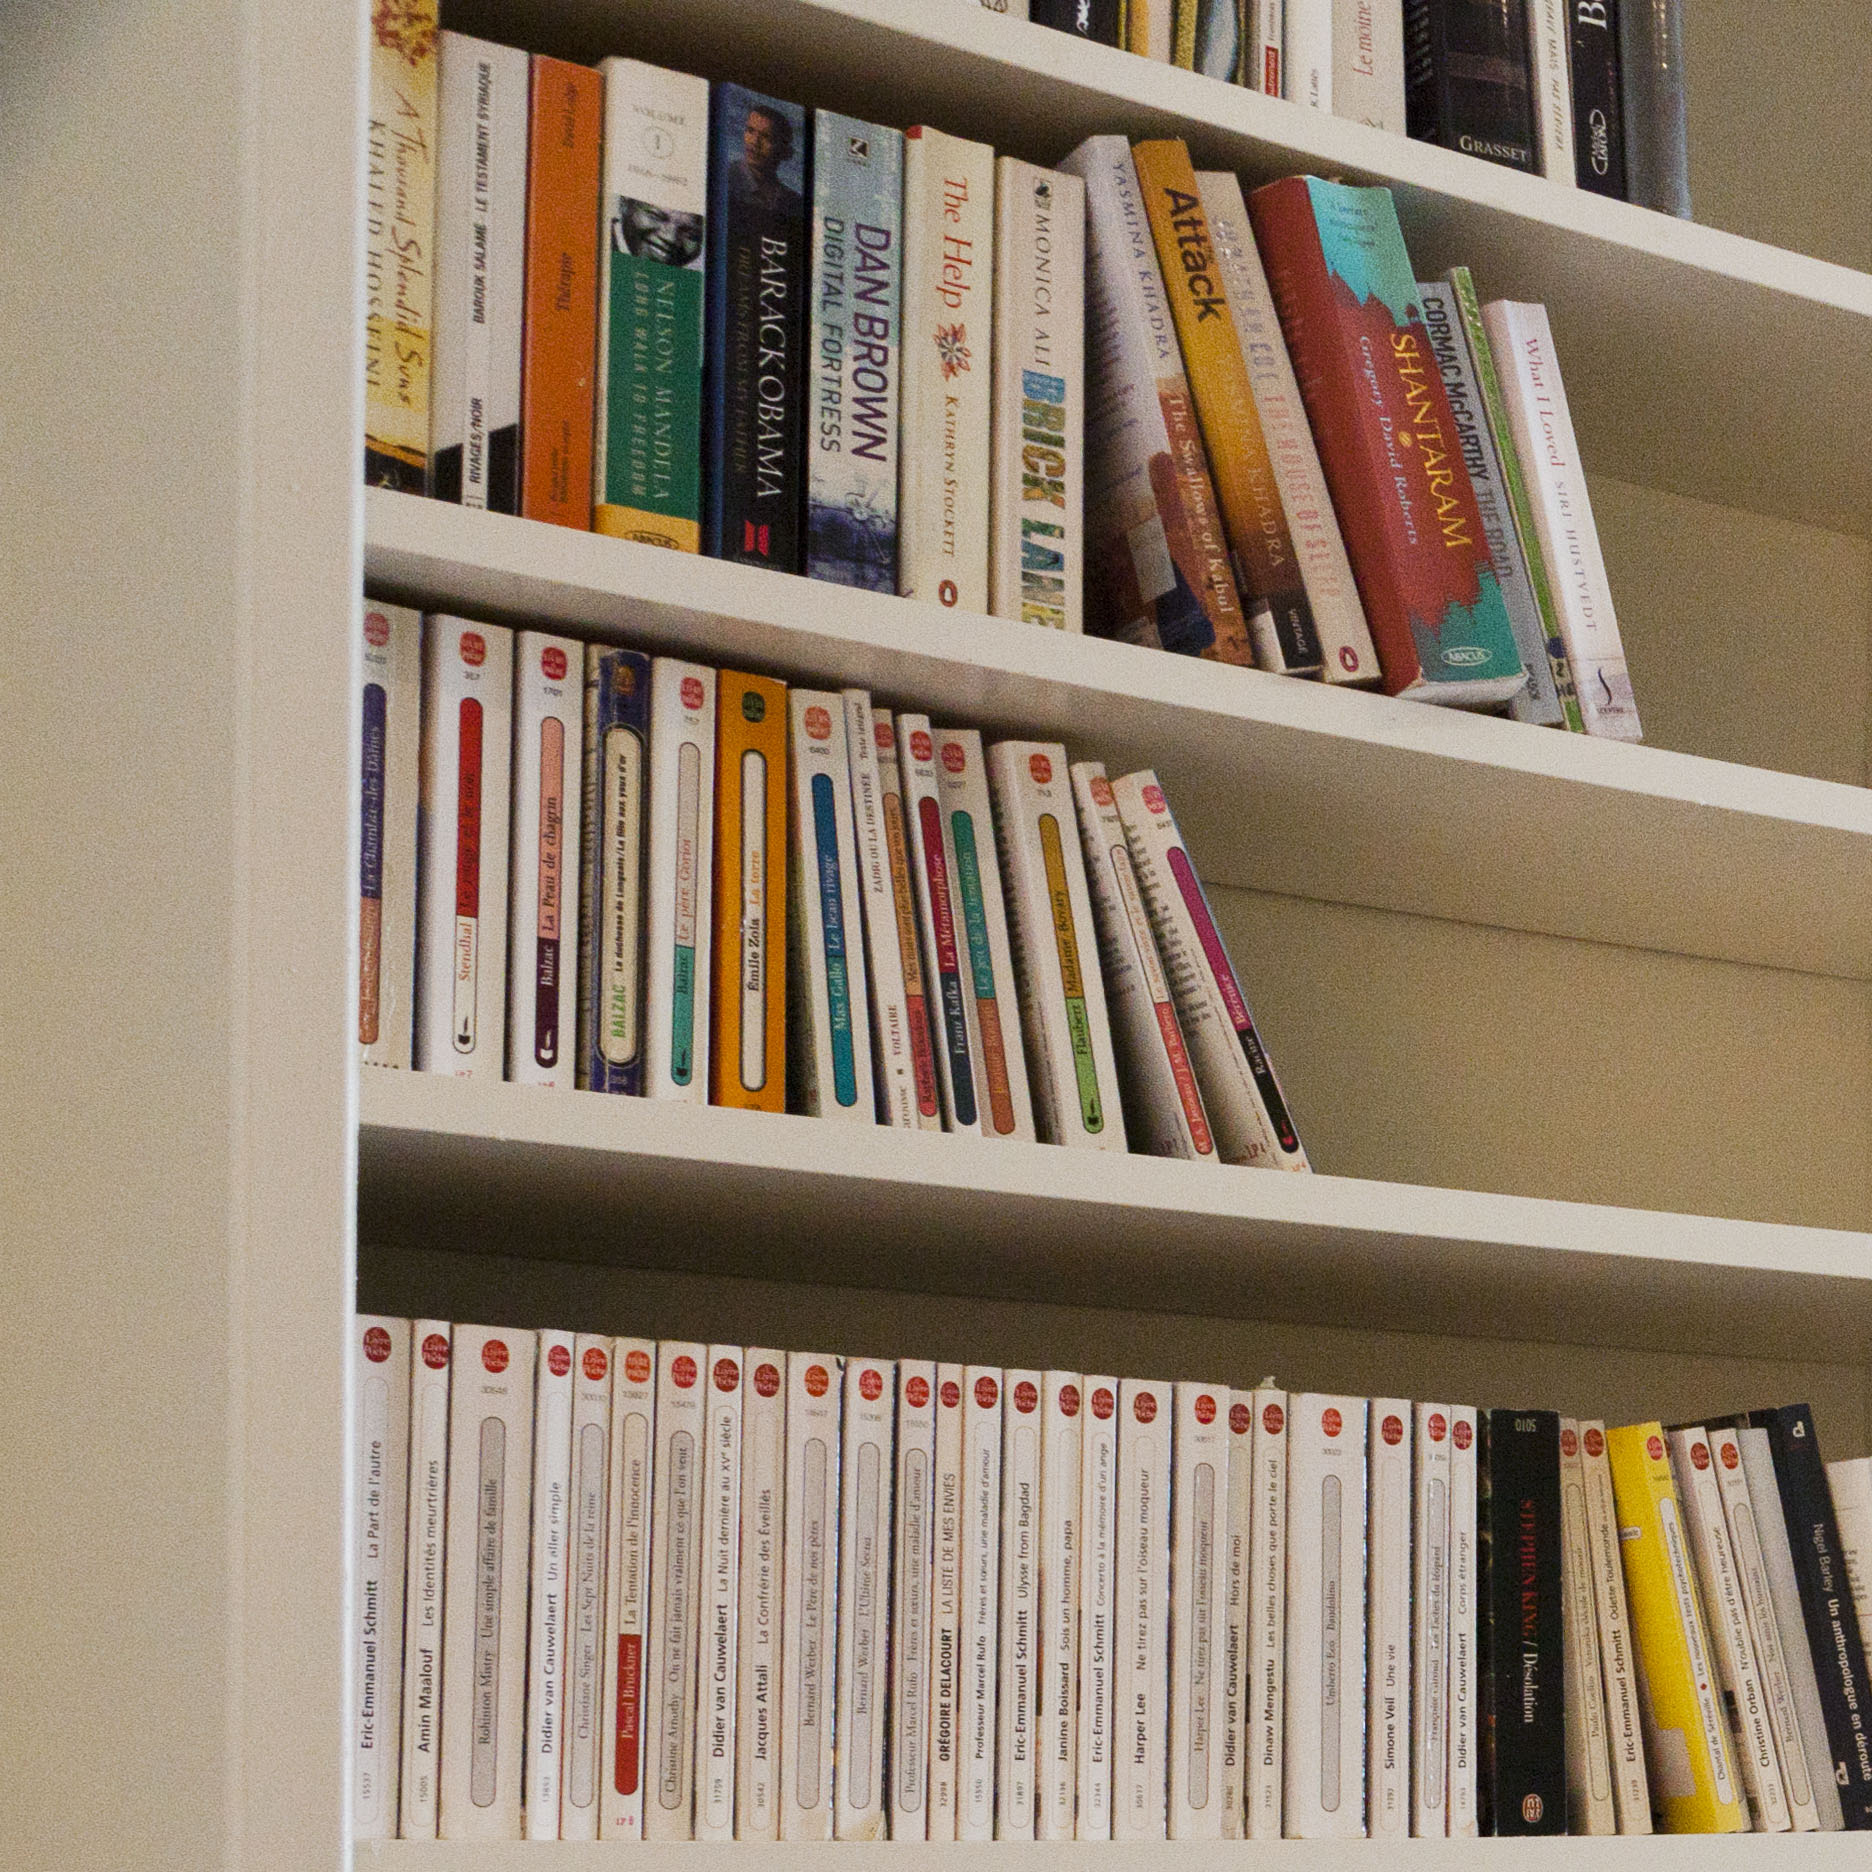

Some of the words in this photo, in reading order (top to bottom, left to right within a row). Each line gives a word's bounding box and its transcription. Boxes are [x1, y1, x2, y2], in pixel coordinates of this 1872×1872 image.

[395, 96, 419, 117] A
[477, 62, 492, 121] SYRIAQUE
[476, 124, 490, 195] TESTAMENT
[1459, 134, 1528, 162] GRASSET
[393, 126, 428, 222] Thousand
[943, 176, 972, 222] The
[475, 199, 487, 213] LE
[820, 216, 846, 312] DIGITAL
[852, 222, 892, 305] DAN
[936, 234, 973, 310] Help
[1034, 215, 1052, 318] MONICA
[1112, 162, 1147, 259] YASMINA
[1138, 269, 1171, 360] KHADRA
[1164, 187, 1226, 323] Attack
[392, 229, 423, 338] Splendid
[473, 274, 486, 324] BAROUK
[757, 235, 787, 374] BARACK
[653, 279, 674, 374] NELSON
[1034, 330, 1051, 368] ALI
[399, 351, 423, 405] Suns
[820, 322, 844, 452] FORTRESS
[851, 311, 889, 461] BROWN
[1523, 338, 1544, 388] What
[1423, 297, 1462, 377] CORMAC
[1444, 381, 1489, 482] McCARTHY
[1532, 394, 1550, 406] I
[652, 385, 672, 500] MANDELA
[757, 374, 785, 499] OBAMA
[1022, 369, 1066, 510] BRICK
[1358, 335, 1386, 410] Gregory
[1377, 416, 1403, 469] David
[1392, 476, 1421, 545] Roberts
[1388, 332, 1472, 548] SHANTARAM
[1539, 410, 1567, 467] Loved
[1021, 517, 1066, 627] LANE
[542, 796, 562, 847] chagrin
[542, 853, 557, 869] de
[542, 873, 558, 908] Peau
[932, 853, 954, 946] Métamorphose
[542, 915, 557, 932] La
[747, 918, 760, 947] Zola
[457, 922, 473, 982] Stendhal
[541, 946, 554, 987] Balzac
[746, 953, 760, 992] Émile
[943, 951, 956, 966] La
[946, 980, 963, 1016] Kafka
[888, 1004, 902, 1056] VOLTAIRE
[951, 1021, 965, 1054] Franz
[369, 1440, 382, 1486] l'autre
[369, 1490, 380, 1507] de
[368, 1512, 380, 1539] Part
[1812, 1523, 1829, 1553] Nigel
[367, 1544, 379, 1559] La
[1818, 1556, 1836, 1593] Barley
[363, 1580, 378, 1635] Schmitt
[1827, 1599, 1840, 1617] Un
[714, 1604, 728, 1682] Cauwelaert
[940, 1627, 952, 1697] DELACOURT
[1830, 1620, 1860, 1710] anthropologue
[361, 1640, 376, 1749] Eric-Emmanuel
[418, 1648, 433, 1709] Maalouf
[714, 1686, 726, 1711] van
[1134, 1693, 1146, 1715] Lee
[417, 1714, 432, 1753] Amin
[936, 1702, 951, 1762] GRÉGOIRE
[1384, 1697, 1395, 1719] Veil
[1852, 1714, 1862, 1729] en
[713, 1716, 726, 1758] Didier
[1134, 1720, 1147, 1764] Harper
[1385, 1723, 1396, 1769] Simone
